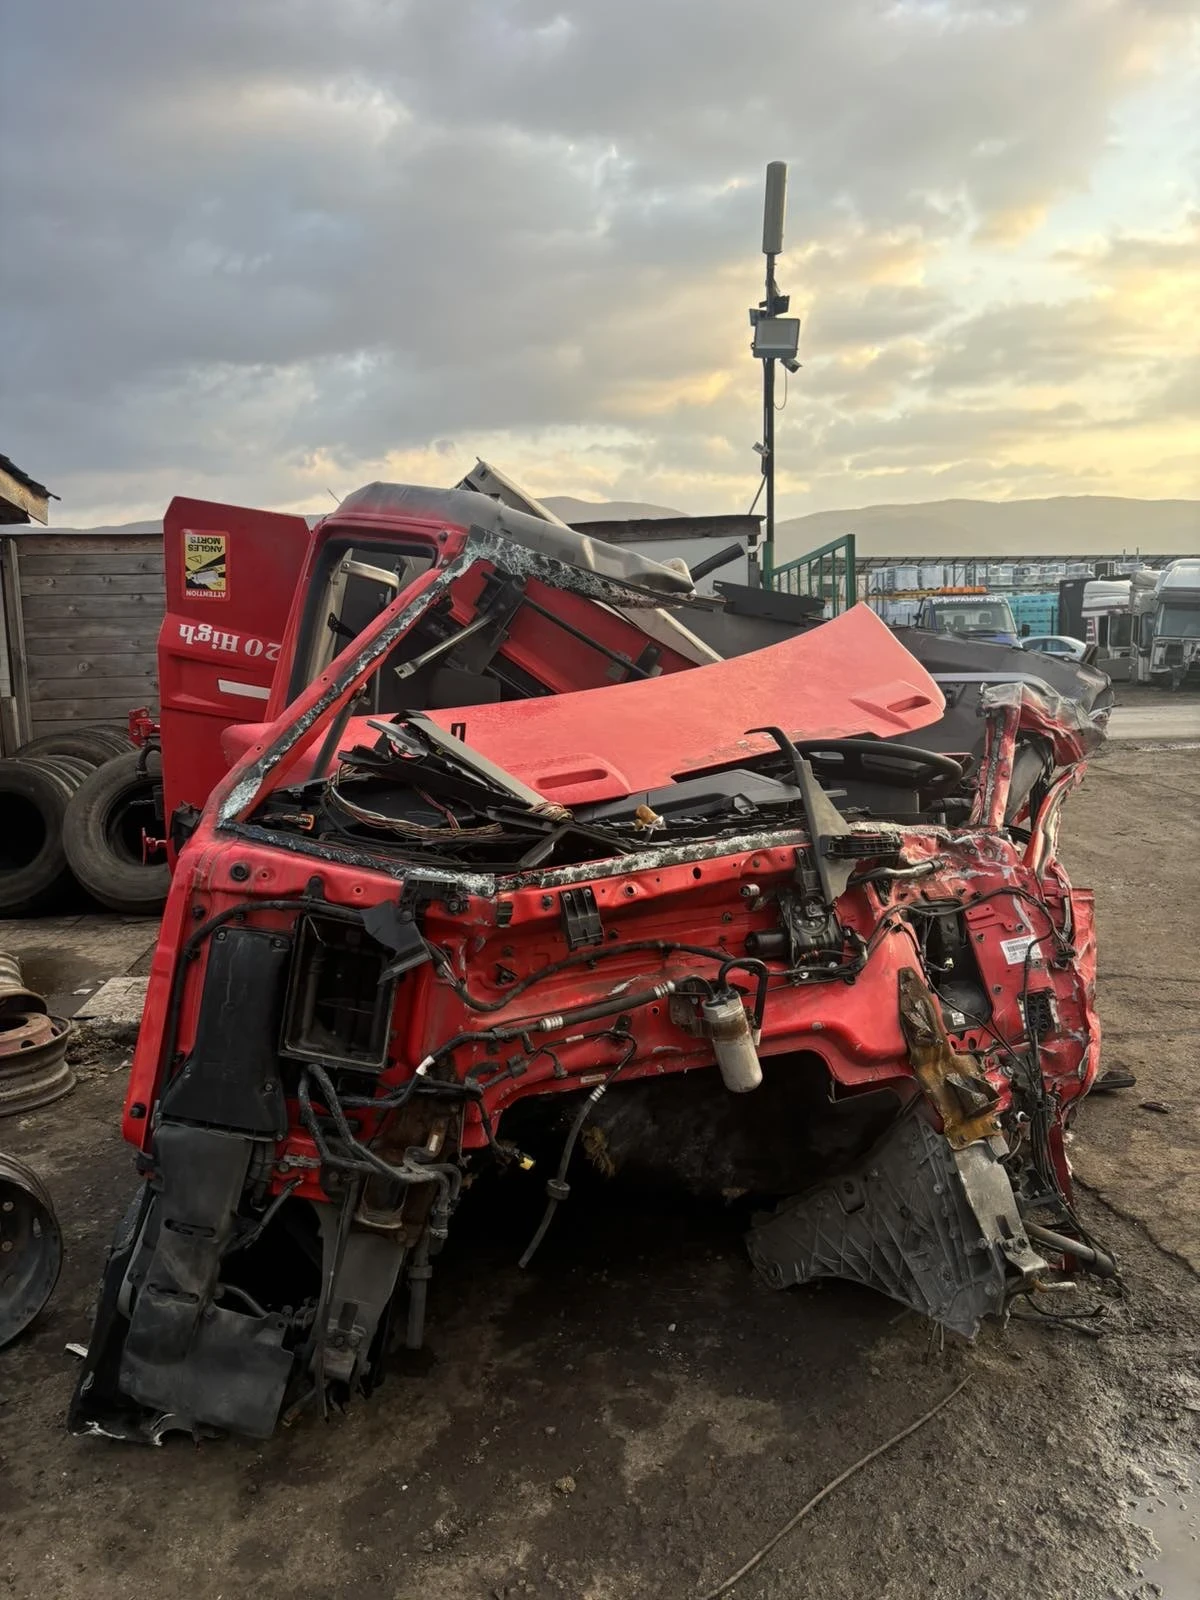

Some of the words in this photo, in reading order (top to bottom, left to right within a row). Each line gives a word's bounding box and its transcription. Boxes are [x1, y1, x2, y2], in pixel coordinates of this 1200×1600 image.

[190, 536, 221, 544] MORTS
[187, 544, 223, 552] ANGLES
[186, 590, 226, 598] ATTENTION
[179, 623, 240, 652] High
